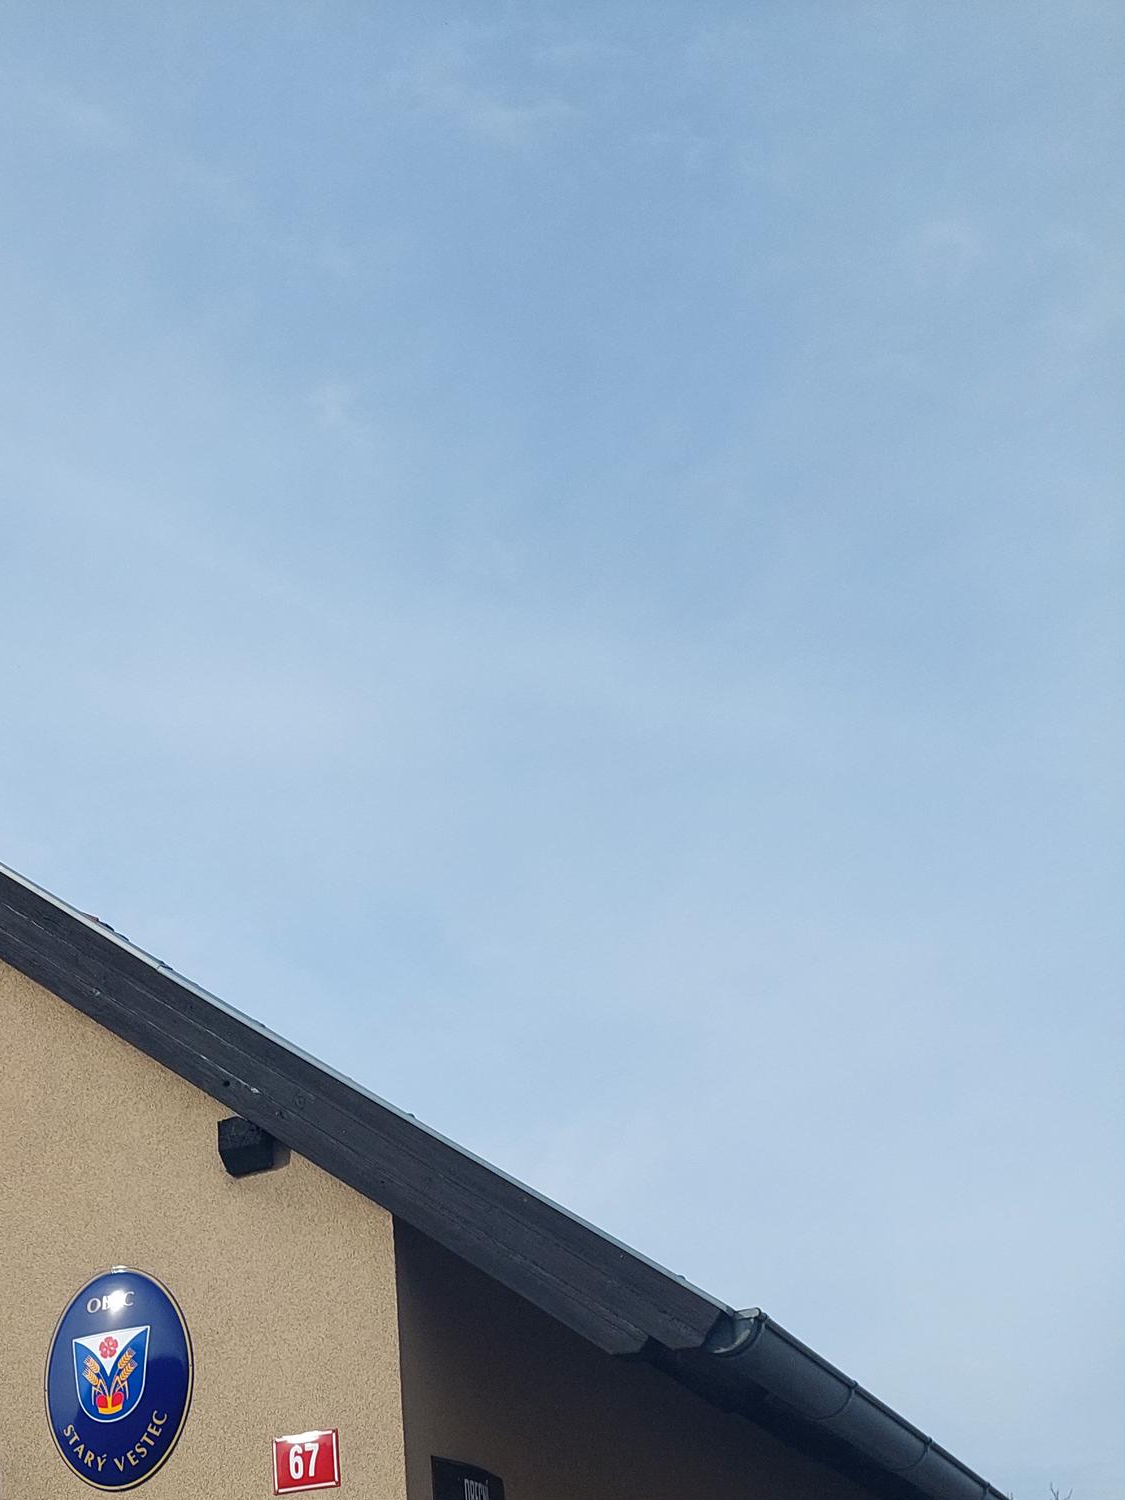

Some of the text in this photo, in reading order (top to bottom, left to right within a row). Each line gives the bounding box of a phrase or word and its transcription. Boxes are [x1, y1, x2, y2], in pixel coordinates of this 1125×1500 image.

[86, 1291, 135, 1314] OBC
[63, 1410, 168, 1473] STARÝ VESTEC
[289, 1442, 320, 1480] 67
